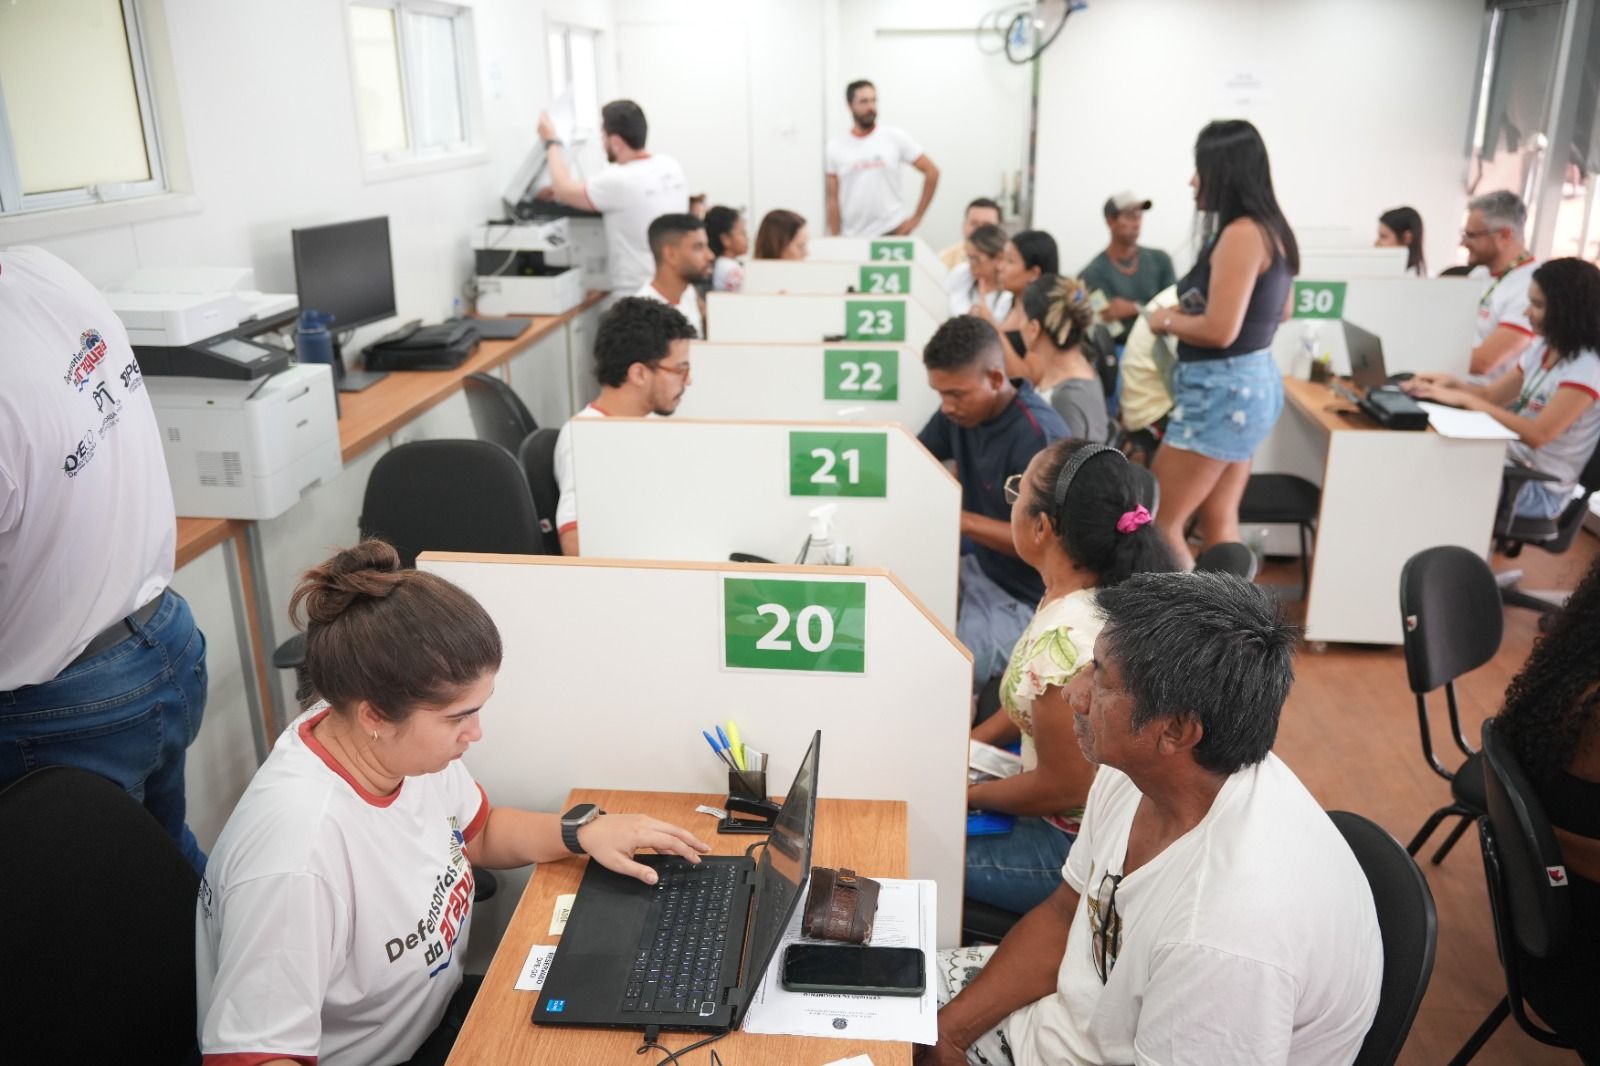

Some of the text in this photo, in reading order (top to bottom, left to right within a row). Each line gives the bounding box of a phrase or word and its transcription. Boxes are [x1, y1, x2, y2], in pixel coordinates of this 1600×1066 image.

[878, 247, 907, 261] 25
[869, 273, 901, 293] 24
[1297, 288, 1334, 313] 30
[857, 309, 893, 335] 23
[838, 361, 883, 391] 22
[810, 447, 860, 484] 21
[756, 603, 834, 653] 20
[385, 865, 458, 963] Defensorias
[424, 939, 444, 966] do
